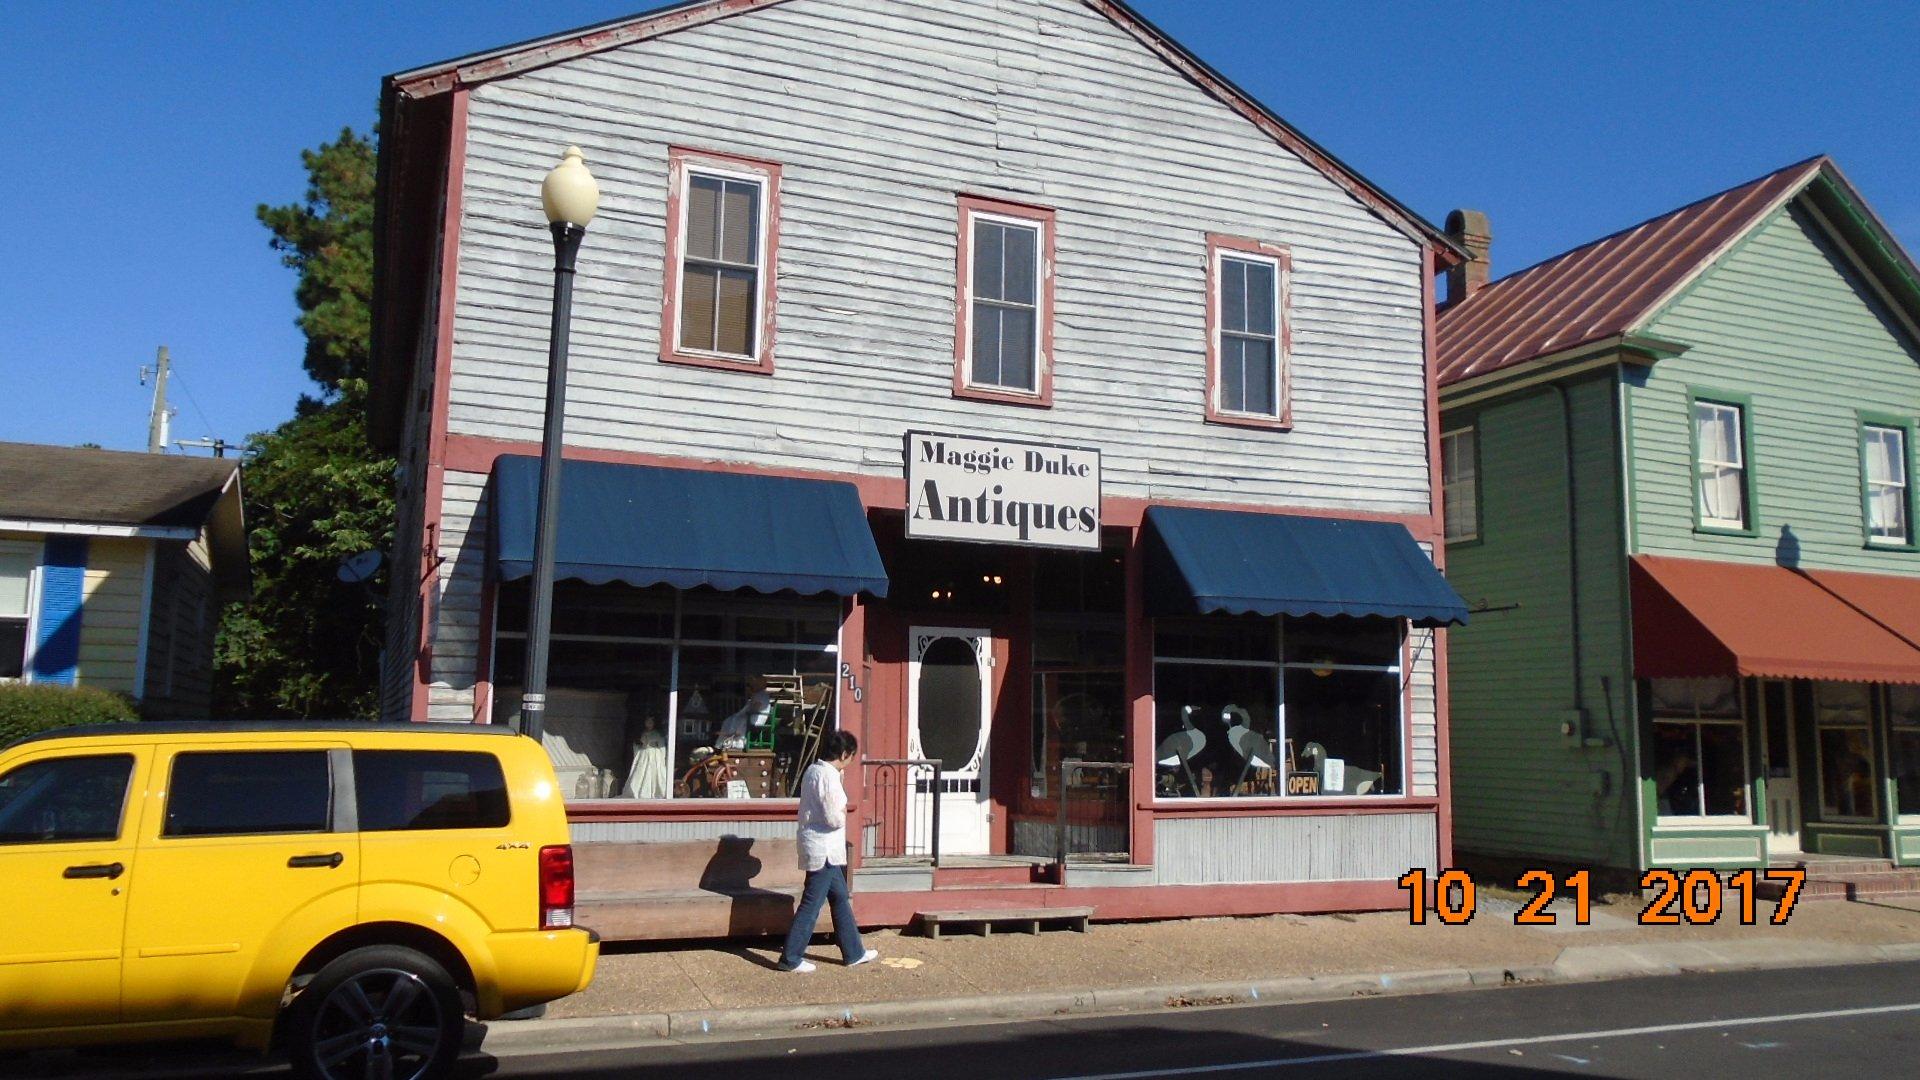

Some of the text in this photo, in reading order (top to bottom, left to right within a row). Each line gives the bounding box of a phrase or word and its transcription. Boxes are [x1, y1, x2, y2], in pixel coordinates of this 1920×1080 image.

[921, 440, 1089, 477] Maggie Duke
[913, 479, 1095, 541] Antiques
[842, 663, 862, 702] 210
[1289, 776, 1317, 793] OPEN
